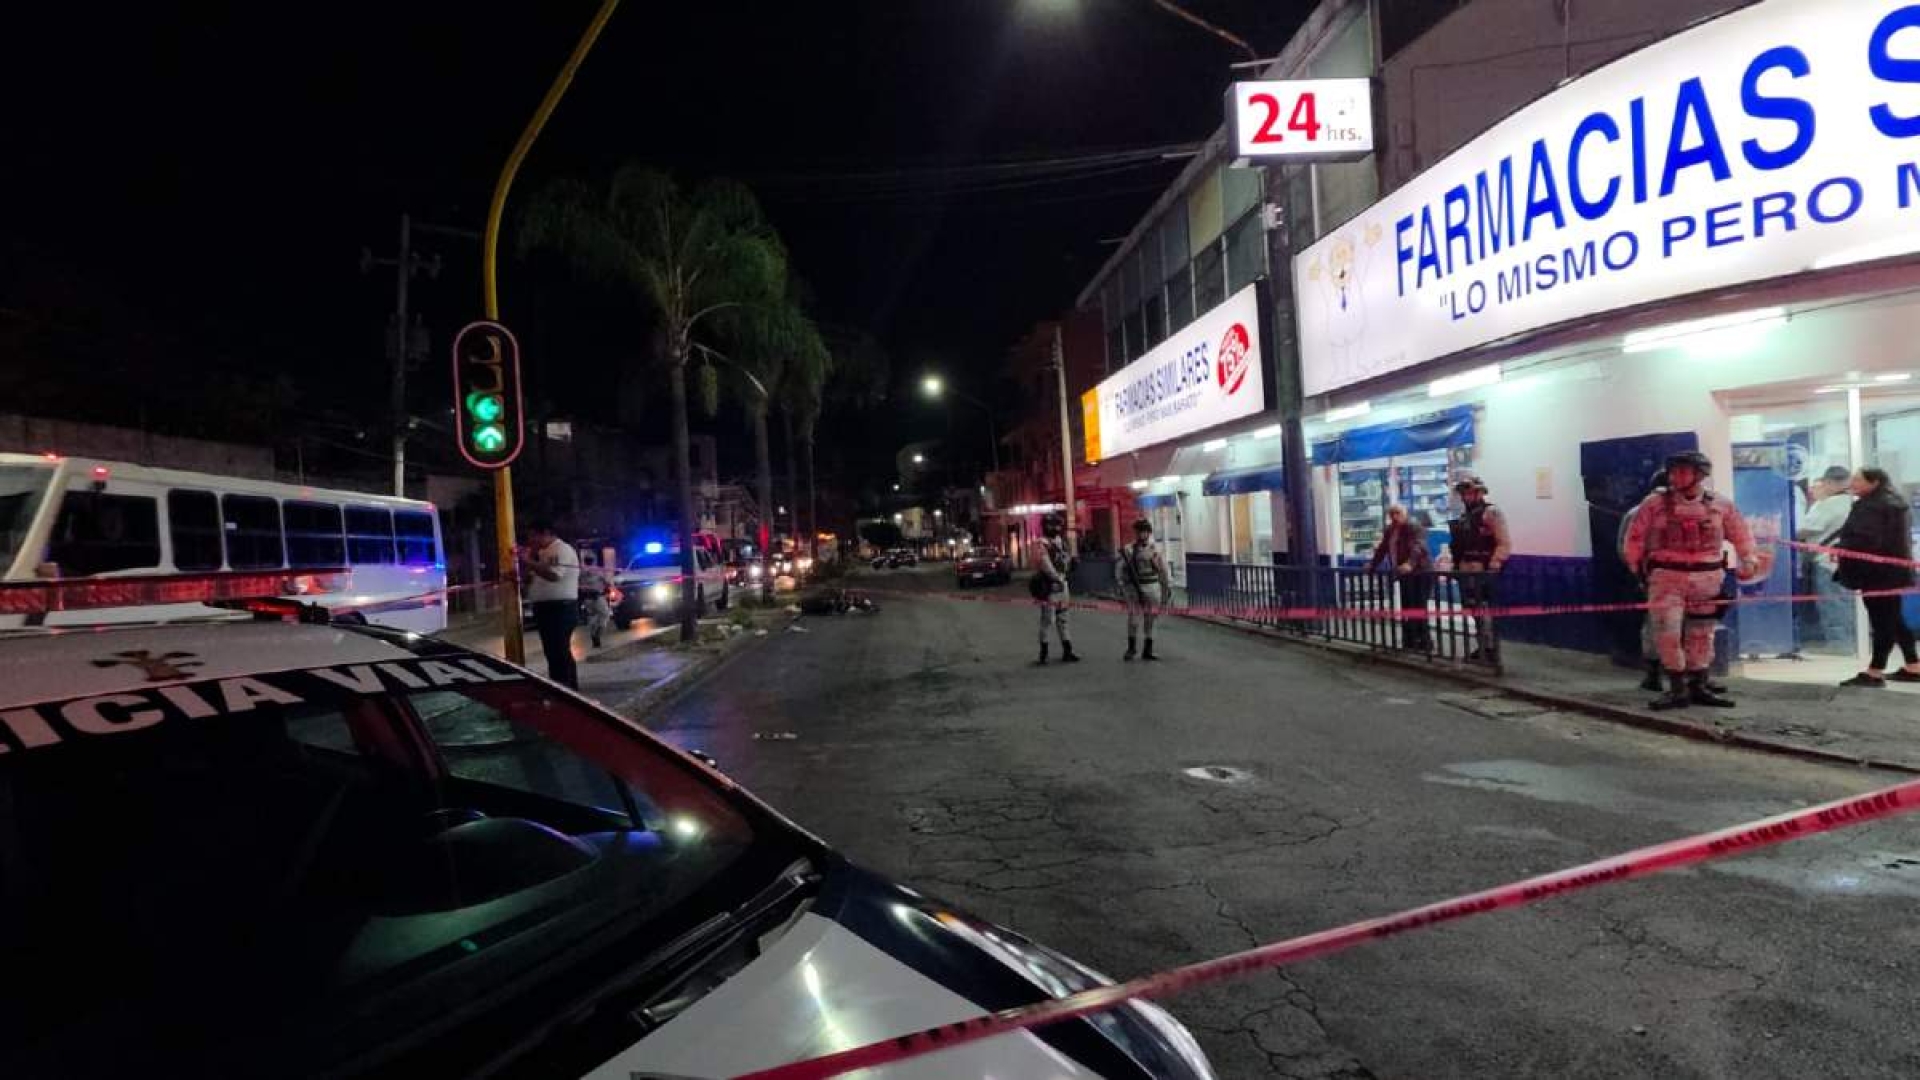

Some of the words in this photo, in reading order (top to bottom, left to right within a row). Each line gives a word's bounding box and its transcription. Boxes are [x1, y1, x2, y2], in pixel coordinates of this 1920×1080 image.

[1247, 92, 1322, 145] 24
[1326, 122, 1363, 142] hrs.
[1395, 44, 1817, 298] FARMACIAS
[1496, 230, 1640, 306] MISMO
[1662, 175, 1864, 259] PERO
[1156, 341, 1210, 401] SIMILARES
[0, 677, 305, 754] ICIA
[307, 657, 527, 694] VIAL
